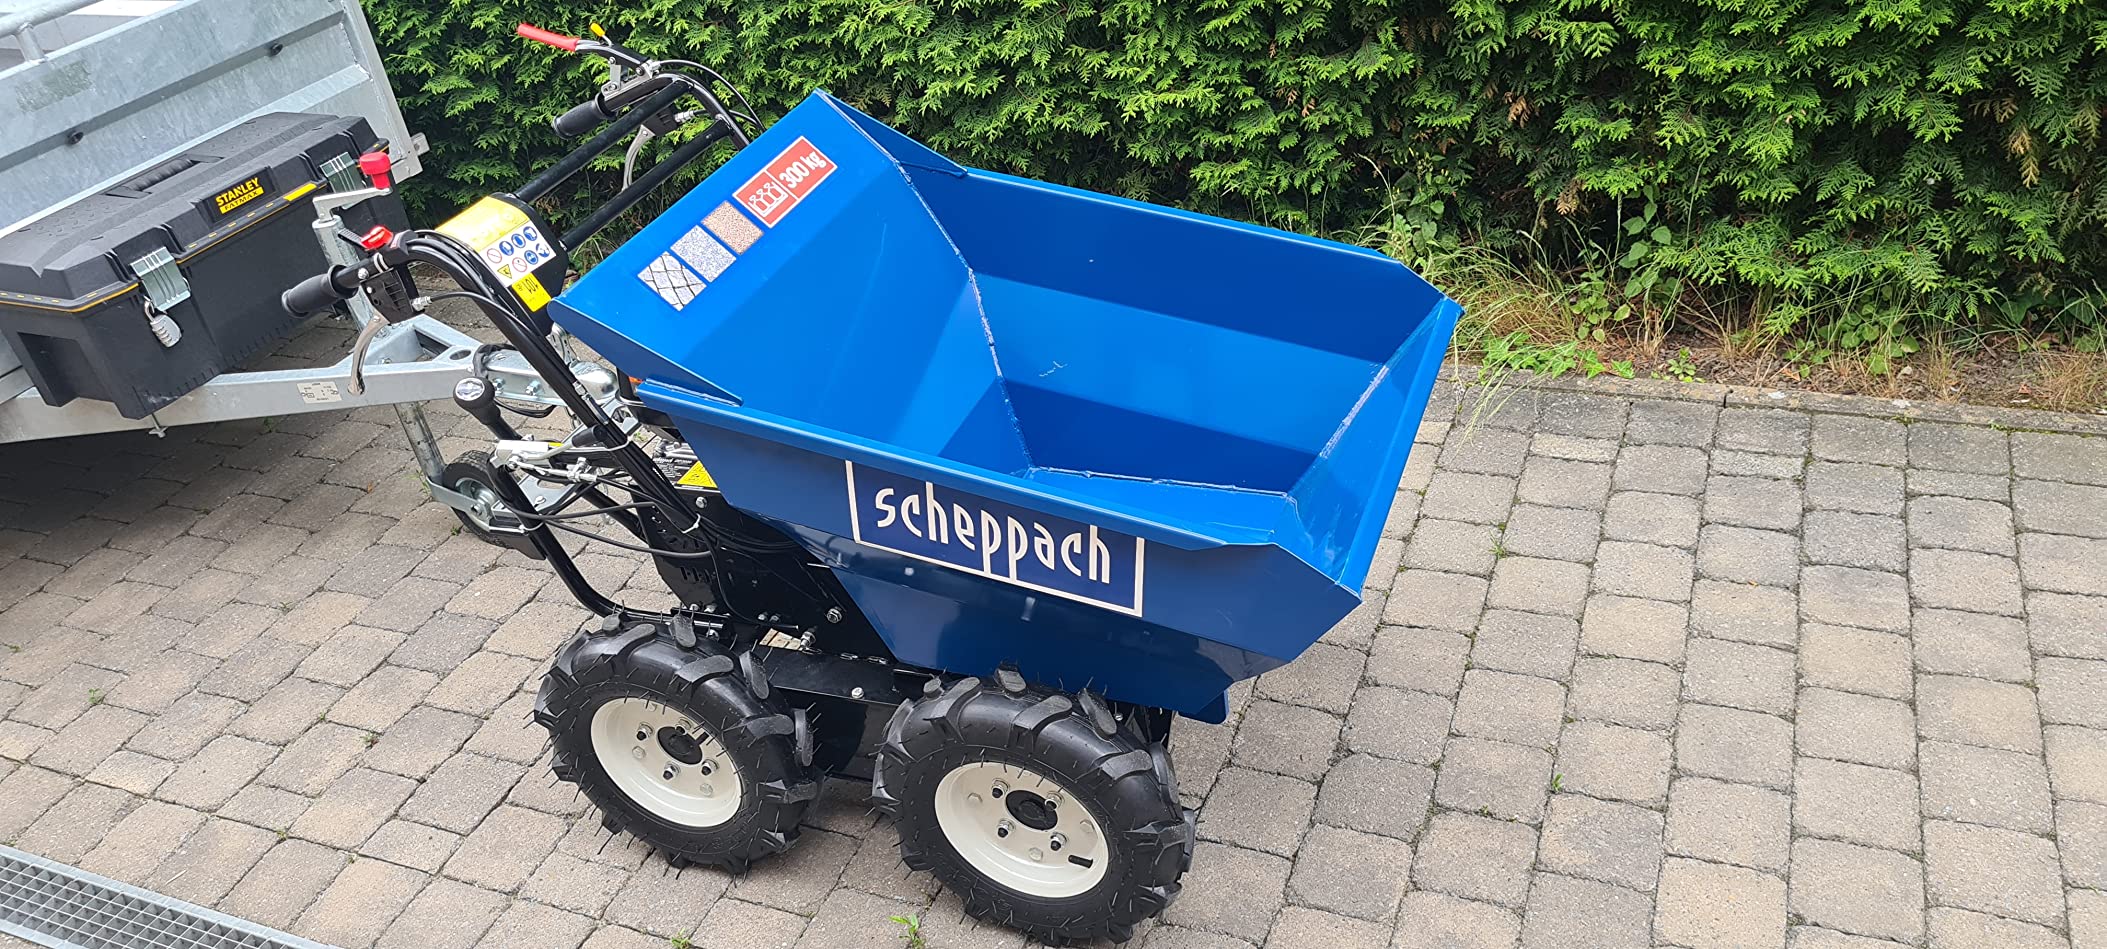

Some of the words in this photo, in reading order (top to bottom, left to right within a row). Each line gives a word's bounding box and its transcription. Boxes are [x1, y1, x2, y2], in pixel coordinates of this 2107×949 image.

[779, 161, 810, 189] 300
[807, 151, 827, 171] kg
[215, 177, 260, 207] STANLEY
[224, 190, 259, 211] FATMAX
[875, 481, 1111, 584] scheppach
